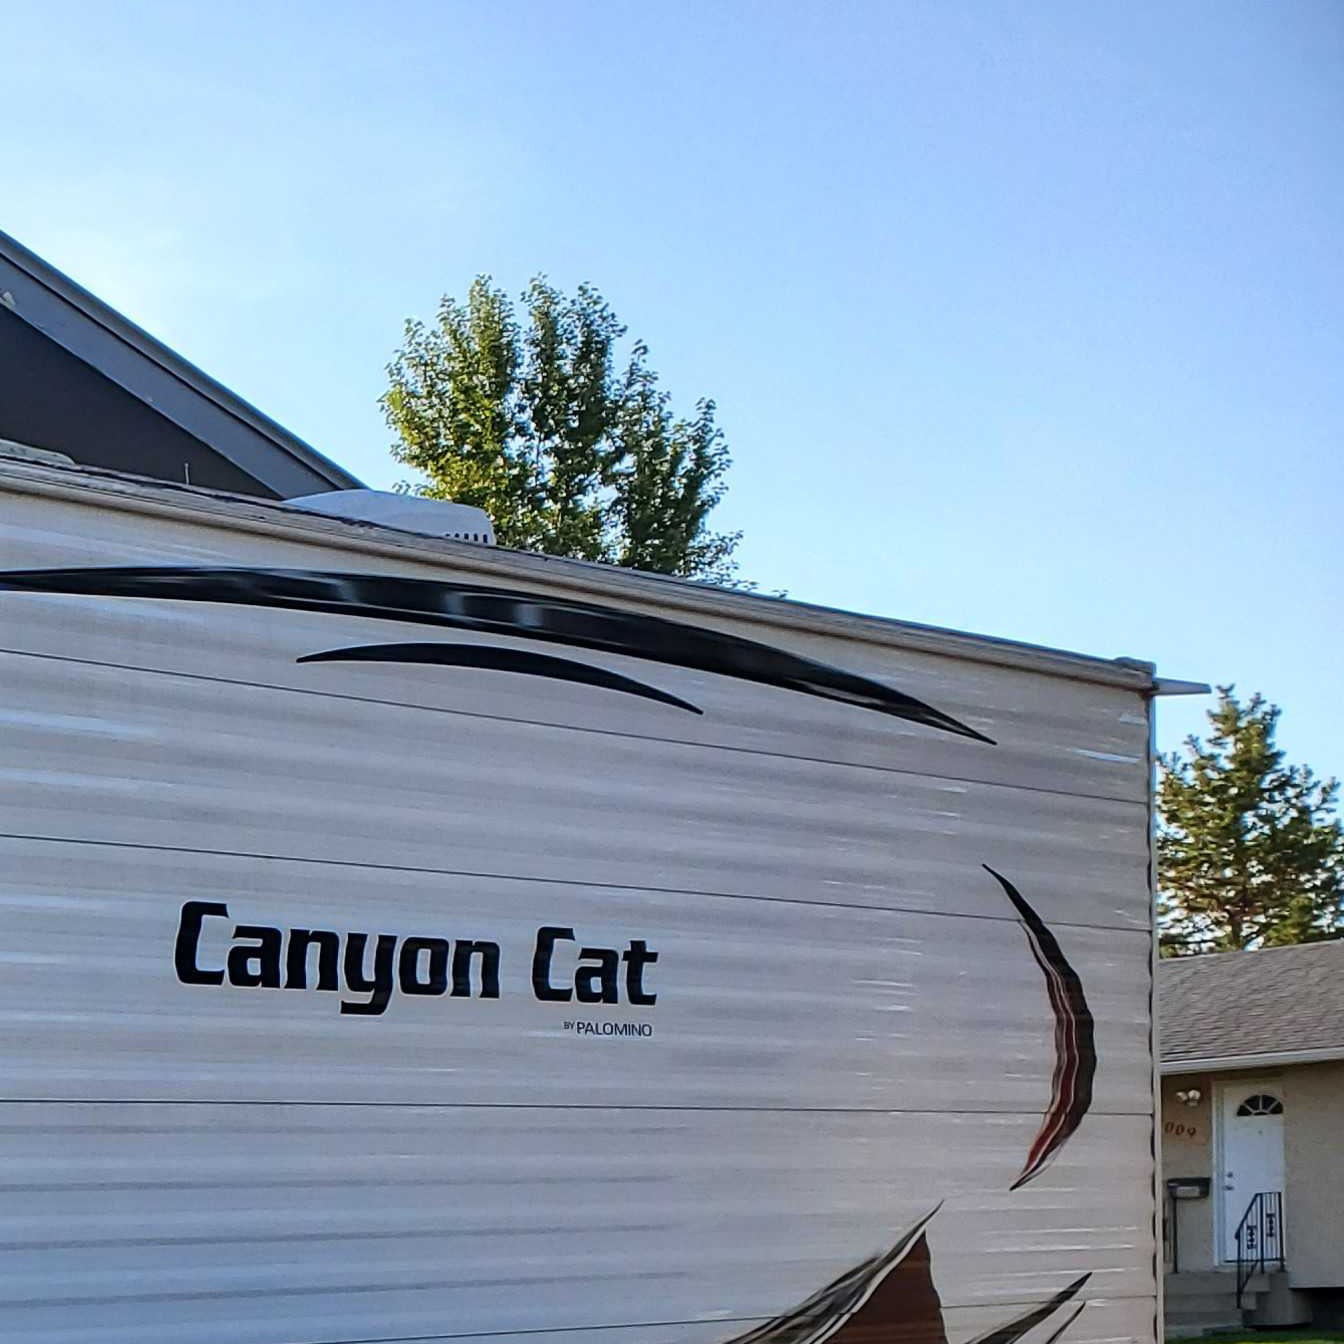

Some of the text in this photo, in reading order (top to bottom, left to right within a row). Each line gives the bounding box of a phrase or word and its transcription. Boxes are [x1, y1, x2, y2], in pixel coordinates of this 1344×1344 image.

[174, 900, 659, 1015] Canyon Cat
[564, 1021, 653, 1037] BY PALOMINO
